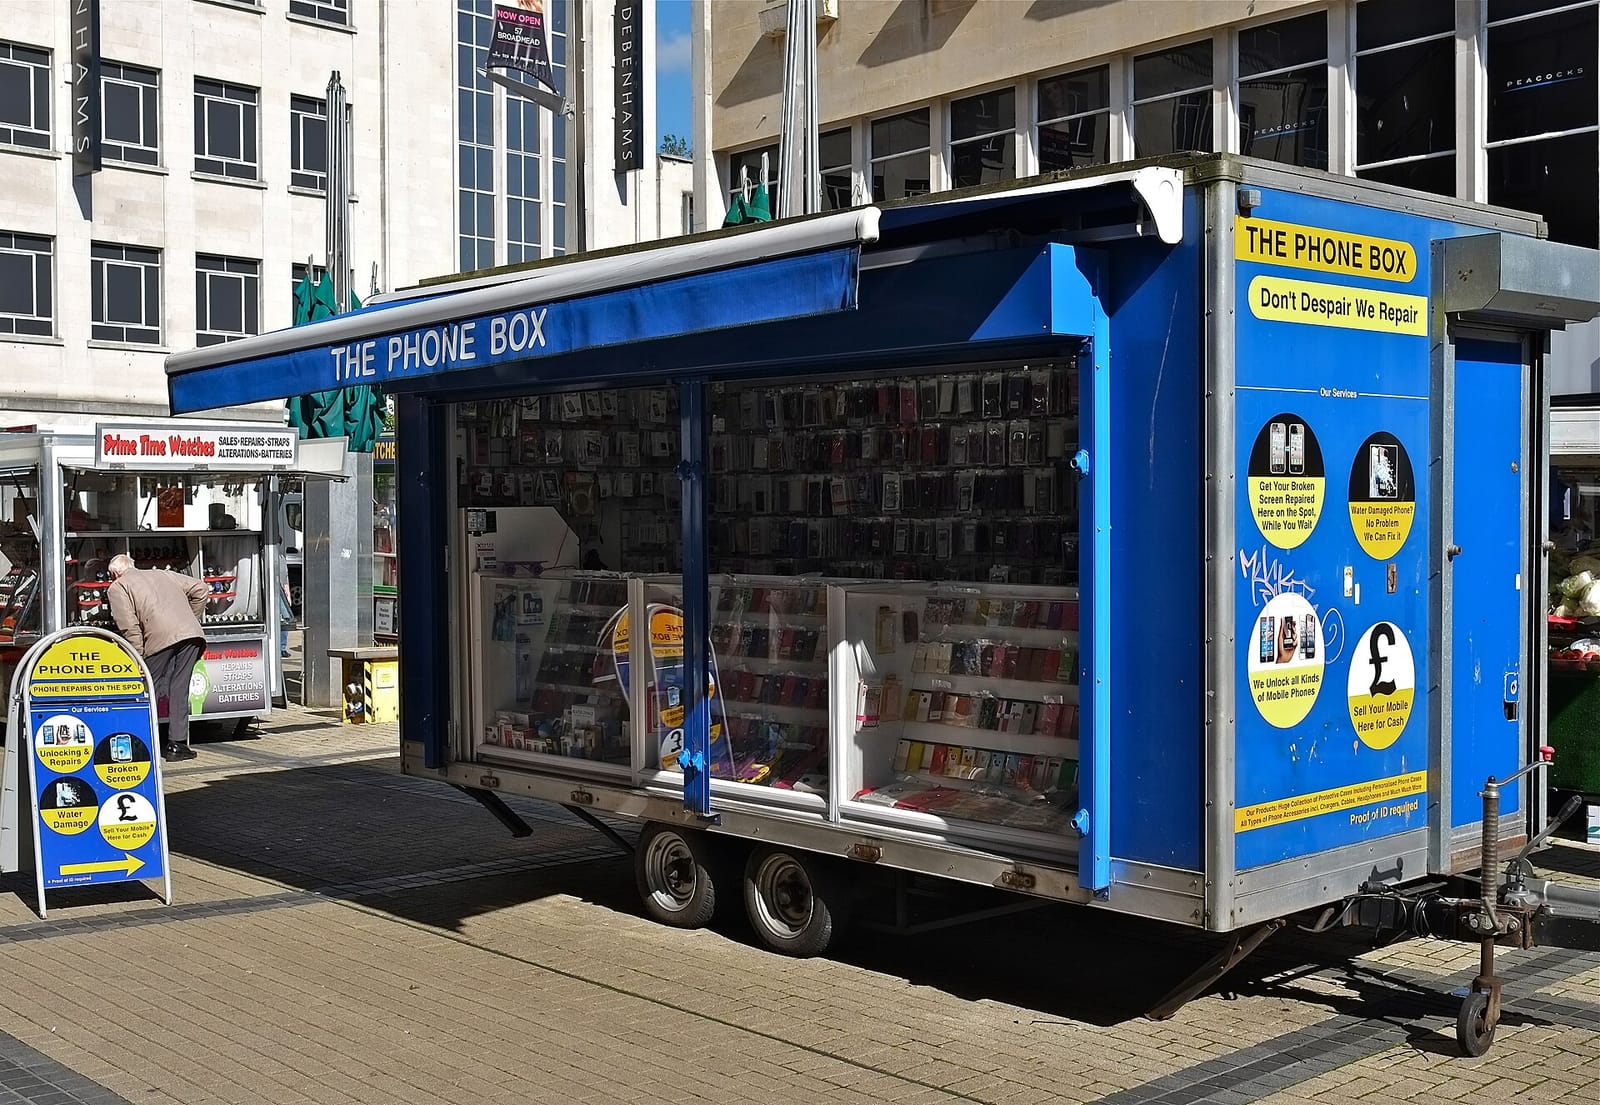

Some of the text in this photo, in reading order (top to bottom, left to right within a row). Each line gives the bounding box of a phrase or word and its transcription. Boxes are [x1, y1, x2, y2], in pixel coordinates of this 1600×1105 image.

[497, 10, 540, 26] NOW OPEN
[514, 27, 523, 35] 57
[621, 6, 633, 160] DEBENHAMS
[1506, 67, 1584, 88] PEACOCKS
[1254, 119, 1316, 136] PEACOCKS
[1246, 226, 1407, 275] THE PHONE BOX
[1260, 287, 1418, 326] Don't Despair We Repair
[331, 308, 548, 382] THE PHONE BOX
[1320, 388, 1358, 398] Our Services
[104, 434, 215, 457] Prime Time Watches
[218, 436, 238, 447] SALES
[267, 437, 290, 448] STRAPS
[260, 449, 292, 460] BATTERIES
[1260, 481, 1315, 491] Get Your Broken
[1259, 494, 1315, 506] Screen Repaired
[1258, 508, 1274, 518] Here
[1276, 509, 1284, 517] on
[1286, 507, 1298, 517] the
[1351, 506, 1413, 516] Water Damaged Phone?
[1262, 520, 1312, 530] While You Wait
[1366, 518, 1399, 528] No Problem
[1364, 532, 1401, 541] We Can Fix it
[69, 652, 100, 661] THE
[39, 664, 134, 674] PHONE BOX
[221, 662, 253, 672] REPAIRS
[224, 672, 253, 682] STRAPS
[1253, 674, 1320, 690] We Unlock all Kinds
[212, 681, 264, 693] ALTERATIONS
[218, 692, 260, 703] BATTERIES
[1258, 686, 1316, 702] of Mobile Phones
[1354, 700, 1408, 716] Sell Your Mobile
[1358, 716, 1404, 732] Here for Cash
[40, 749, 82, 758] Unlocking
[50, 758, 82, 767] Repairs
[108, 766, 138, 774] Broken
[106, 774, 142, 783] Screens
[1278, 803, 1290, 811] Huge
[1290, 798, 1312, 806] Collection
[57, 810, 82, 818] Water
[1350, 799, 1418, 825] Proof of ID required
[1268, 814, 1282, 822] Phone
[53, 820, 88, 828] Damage
[116, 826, 129, 834] Your
